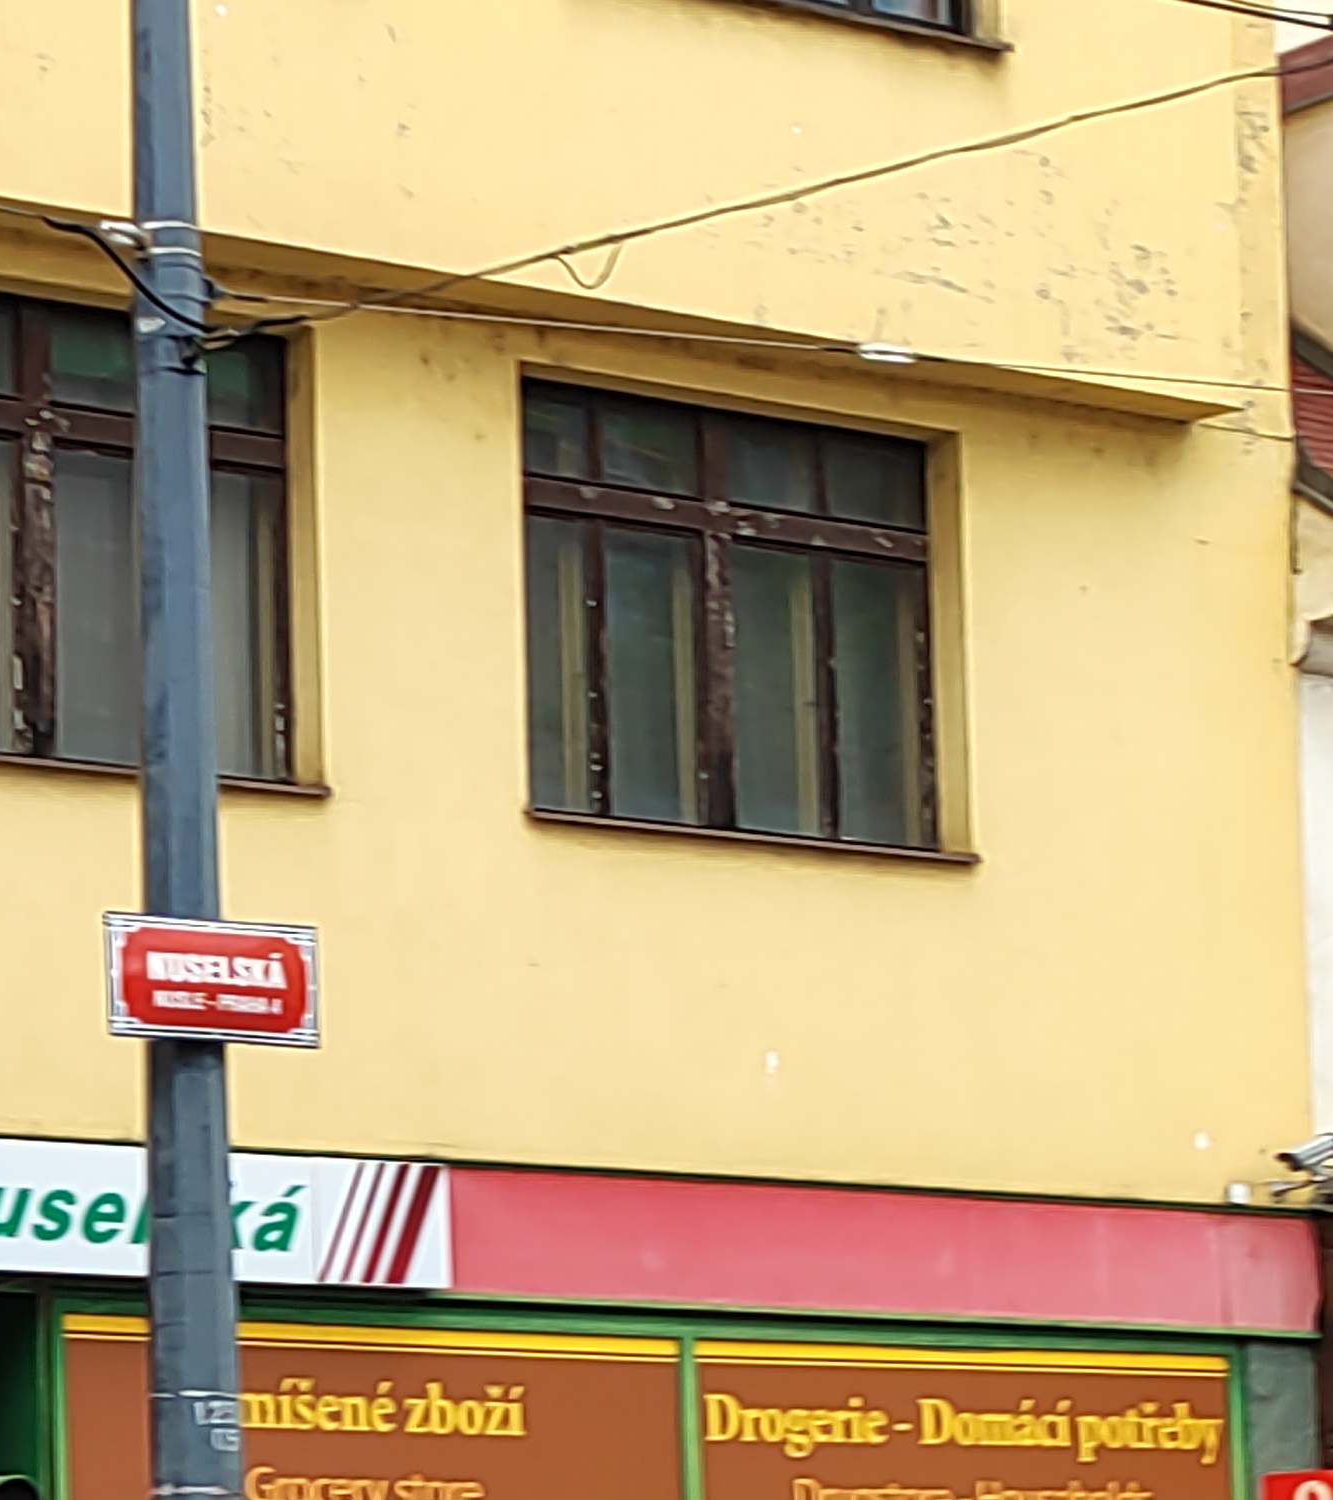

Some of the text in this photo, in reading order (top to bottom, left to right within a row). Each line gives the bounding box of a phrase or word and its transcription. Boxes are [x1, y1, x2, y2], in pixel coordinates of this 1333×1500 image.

[145, 951, 288, 990] NUSELSKÁ
[237, 1377, 398, 1432] míšené
[403, 1382, 527, 1437] zboží
[703, 1394, 890, 1458] Drogerie
[917, 1398, 1072, 1447] Domácí
[1076, 1402, 1225, 1464] potřeby
